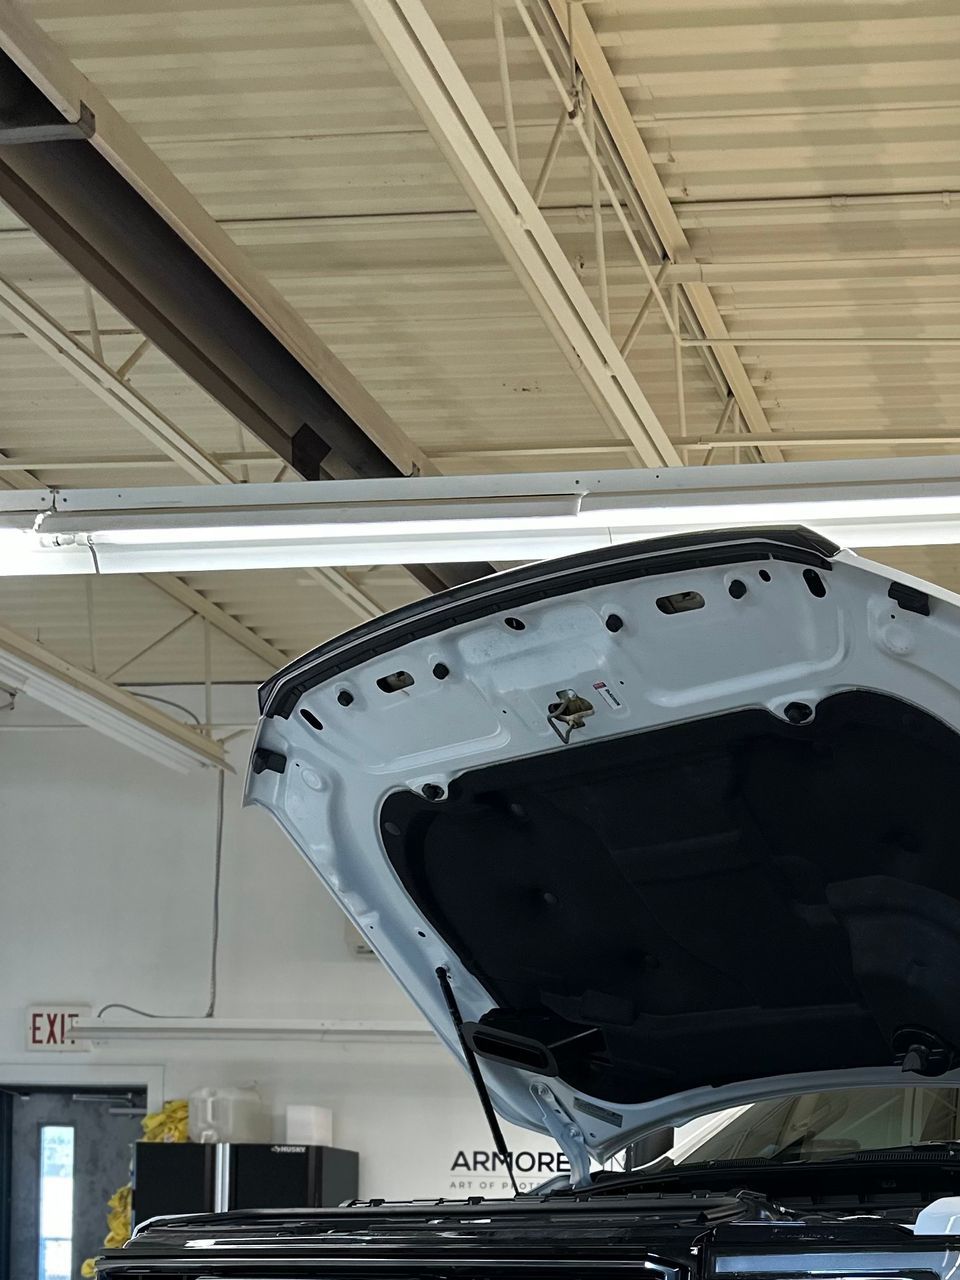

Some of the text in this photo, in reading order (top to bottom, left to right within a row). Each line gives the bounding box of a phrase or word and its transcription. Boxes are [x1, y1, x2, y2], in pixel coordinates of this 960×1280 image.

[450, 1150, 570, 1172] ARMORE
[450, 1181, 539, 1191] ART OF POT
